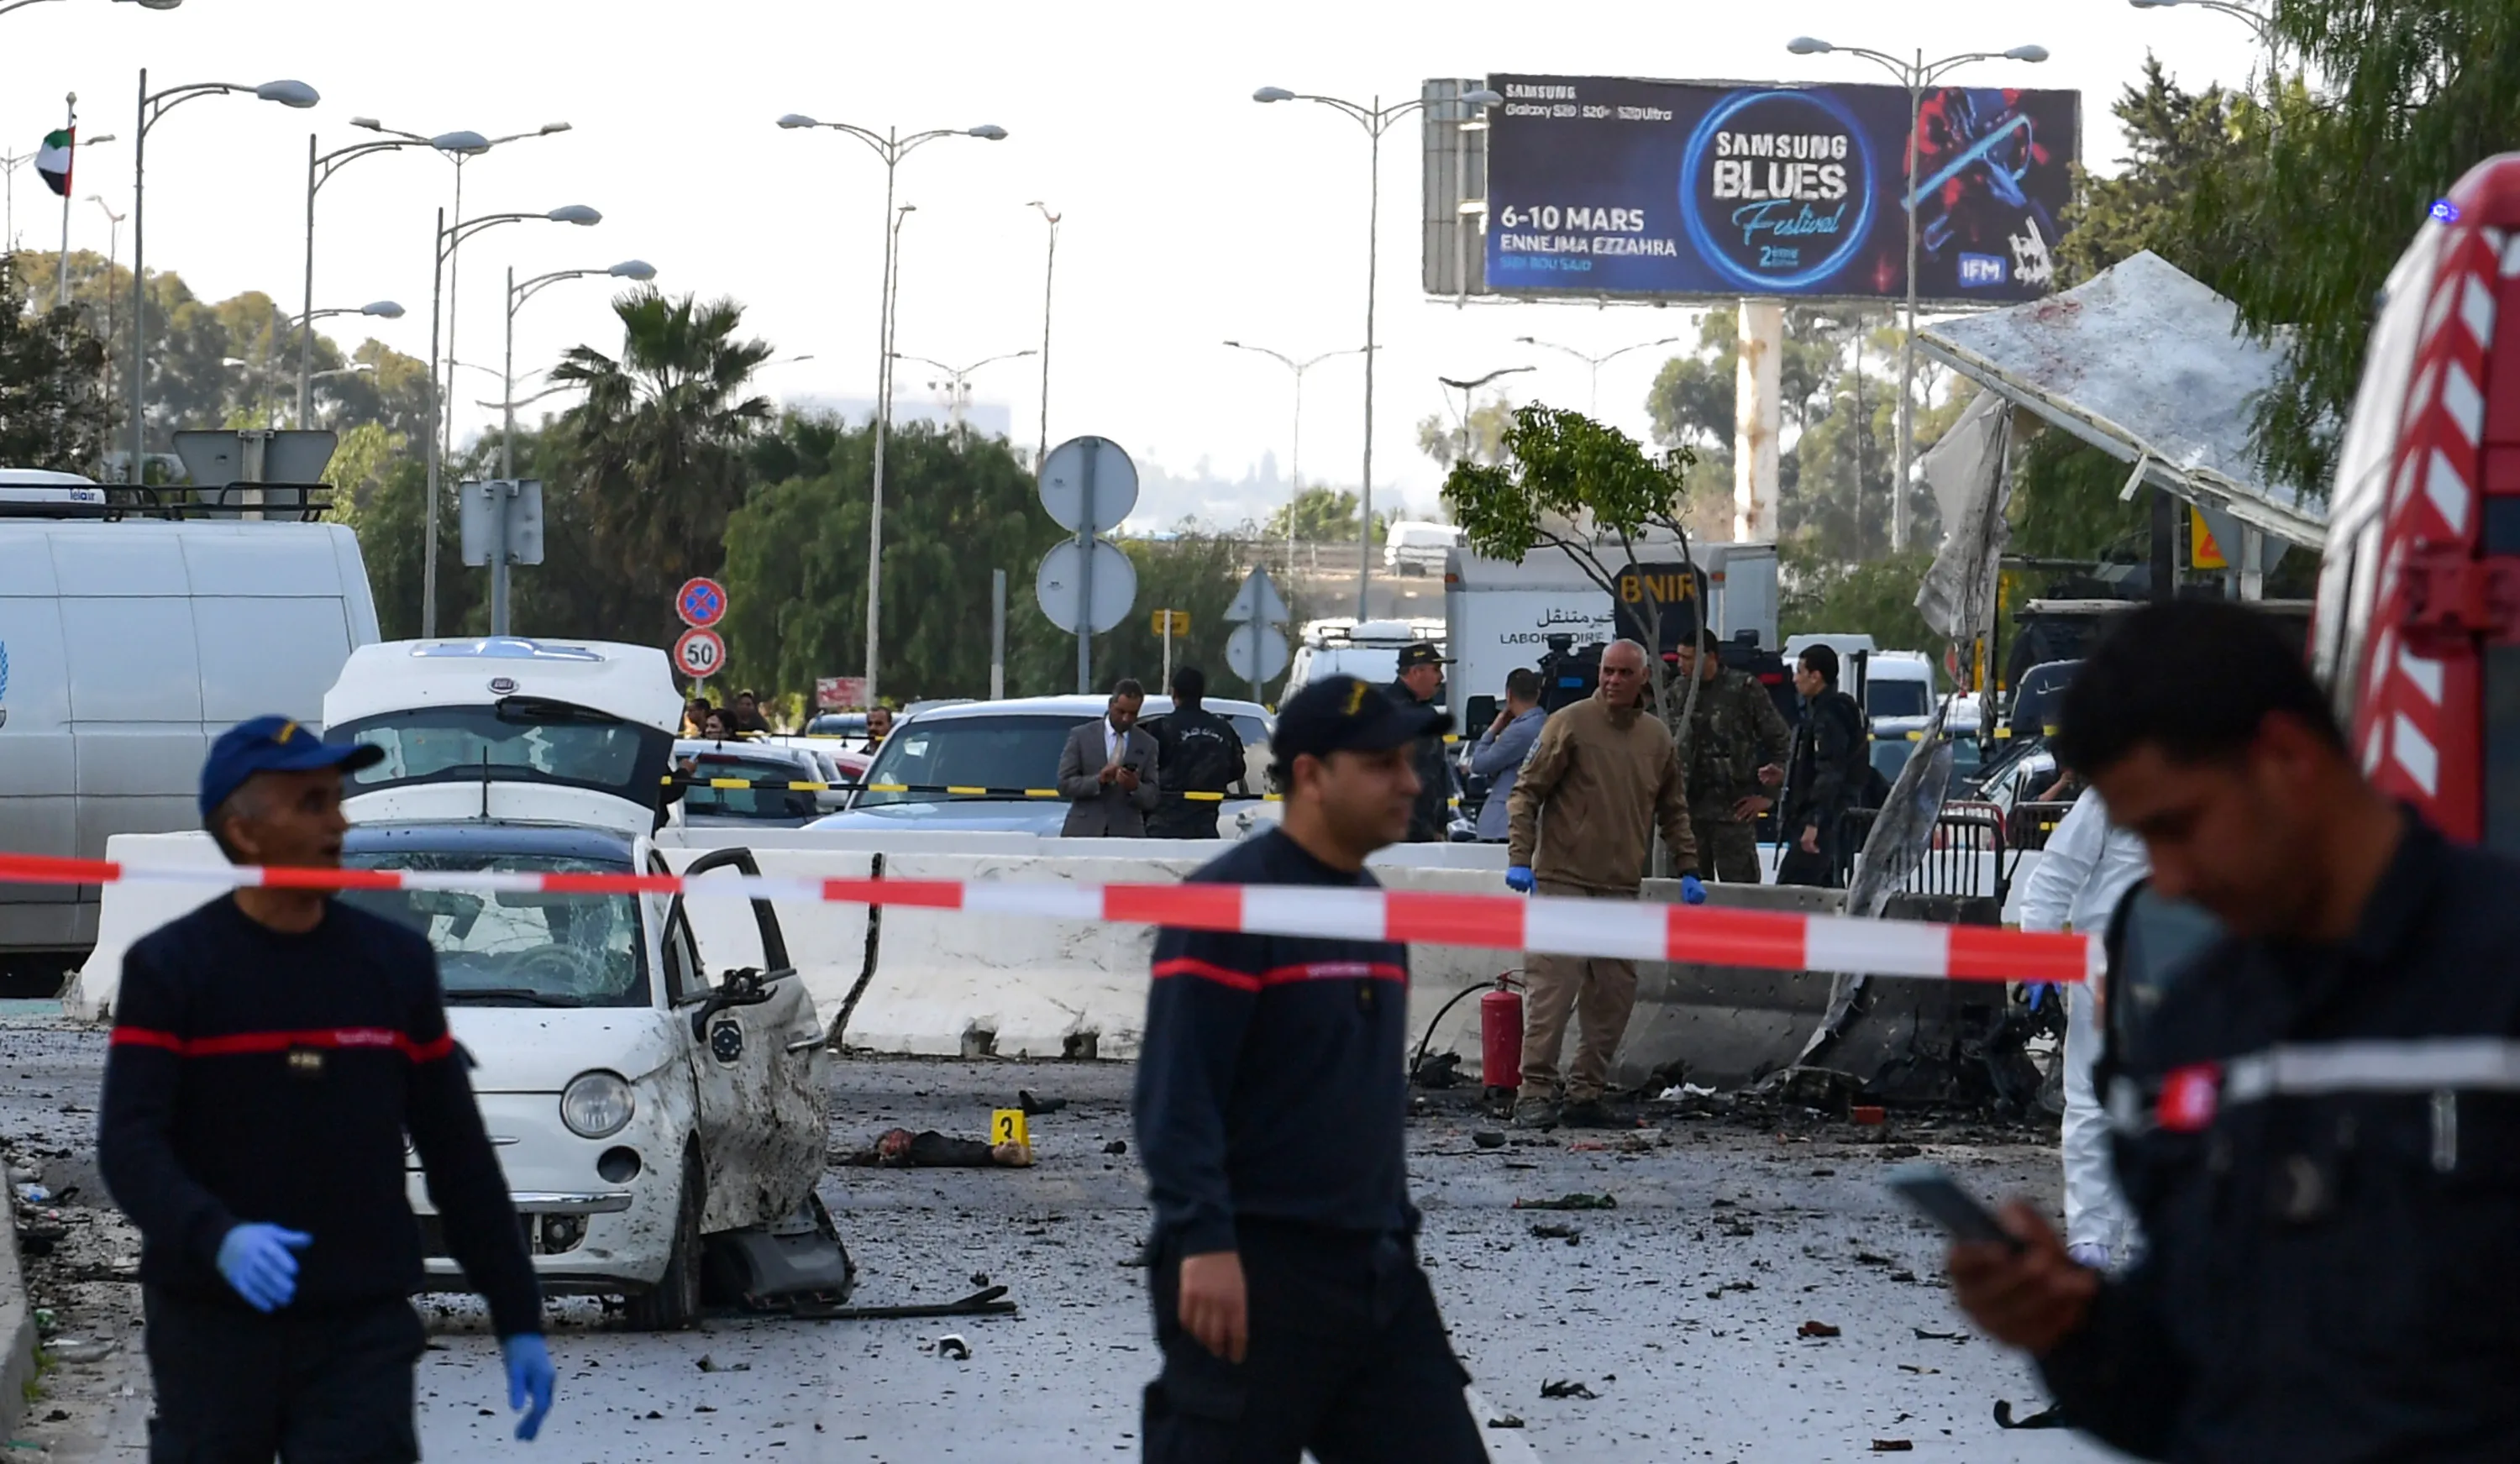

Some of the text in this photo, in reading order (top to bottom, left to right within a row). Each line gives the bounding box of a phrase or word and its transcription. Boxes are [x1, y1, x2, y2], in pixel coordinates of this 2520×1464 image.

[1505, 84, 1577, 99] SAMSUNG
[1505, 103, 1552, 118] Galaxy
[1642, 107, 1672, 121] Ultra
[1716, 131, 1847, 160] SAMSUNG
[1713, 160, 1848, 200] BLUES
[1500, 205, 1644, 232] 6-10 MARS
[1732, 199, 1846, 245] Festival
[1500, 234, 1677, 256] ENNEJMA EZZAHRA
[1962, 259, 2000, 281] IFM
[1620, 574, 1696, 603] BNIR
[1500, 632, 1604, 644] LABOROIRE
[686, 643, 713, 665] 50
